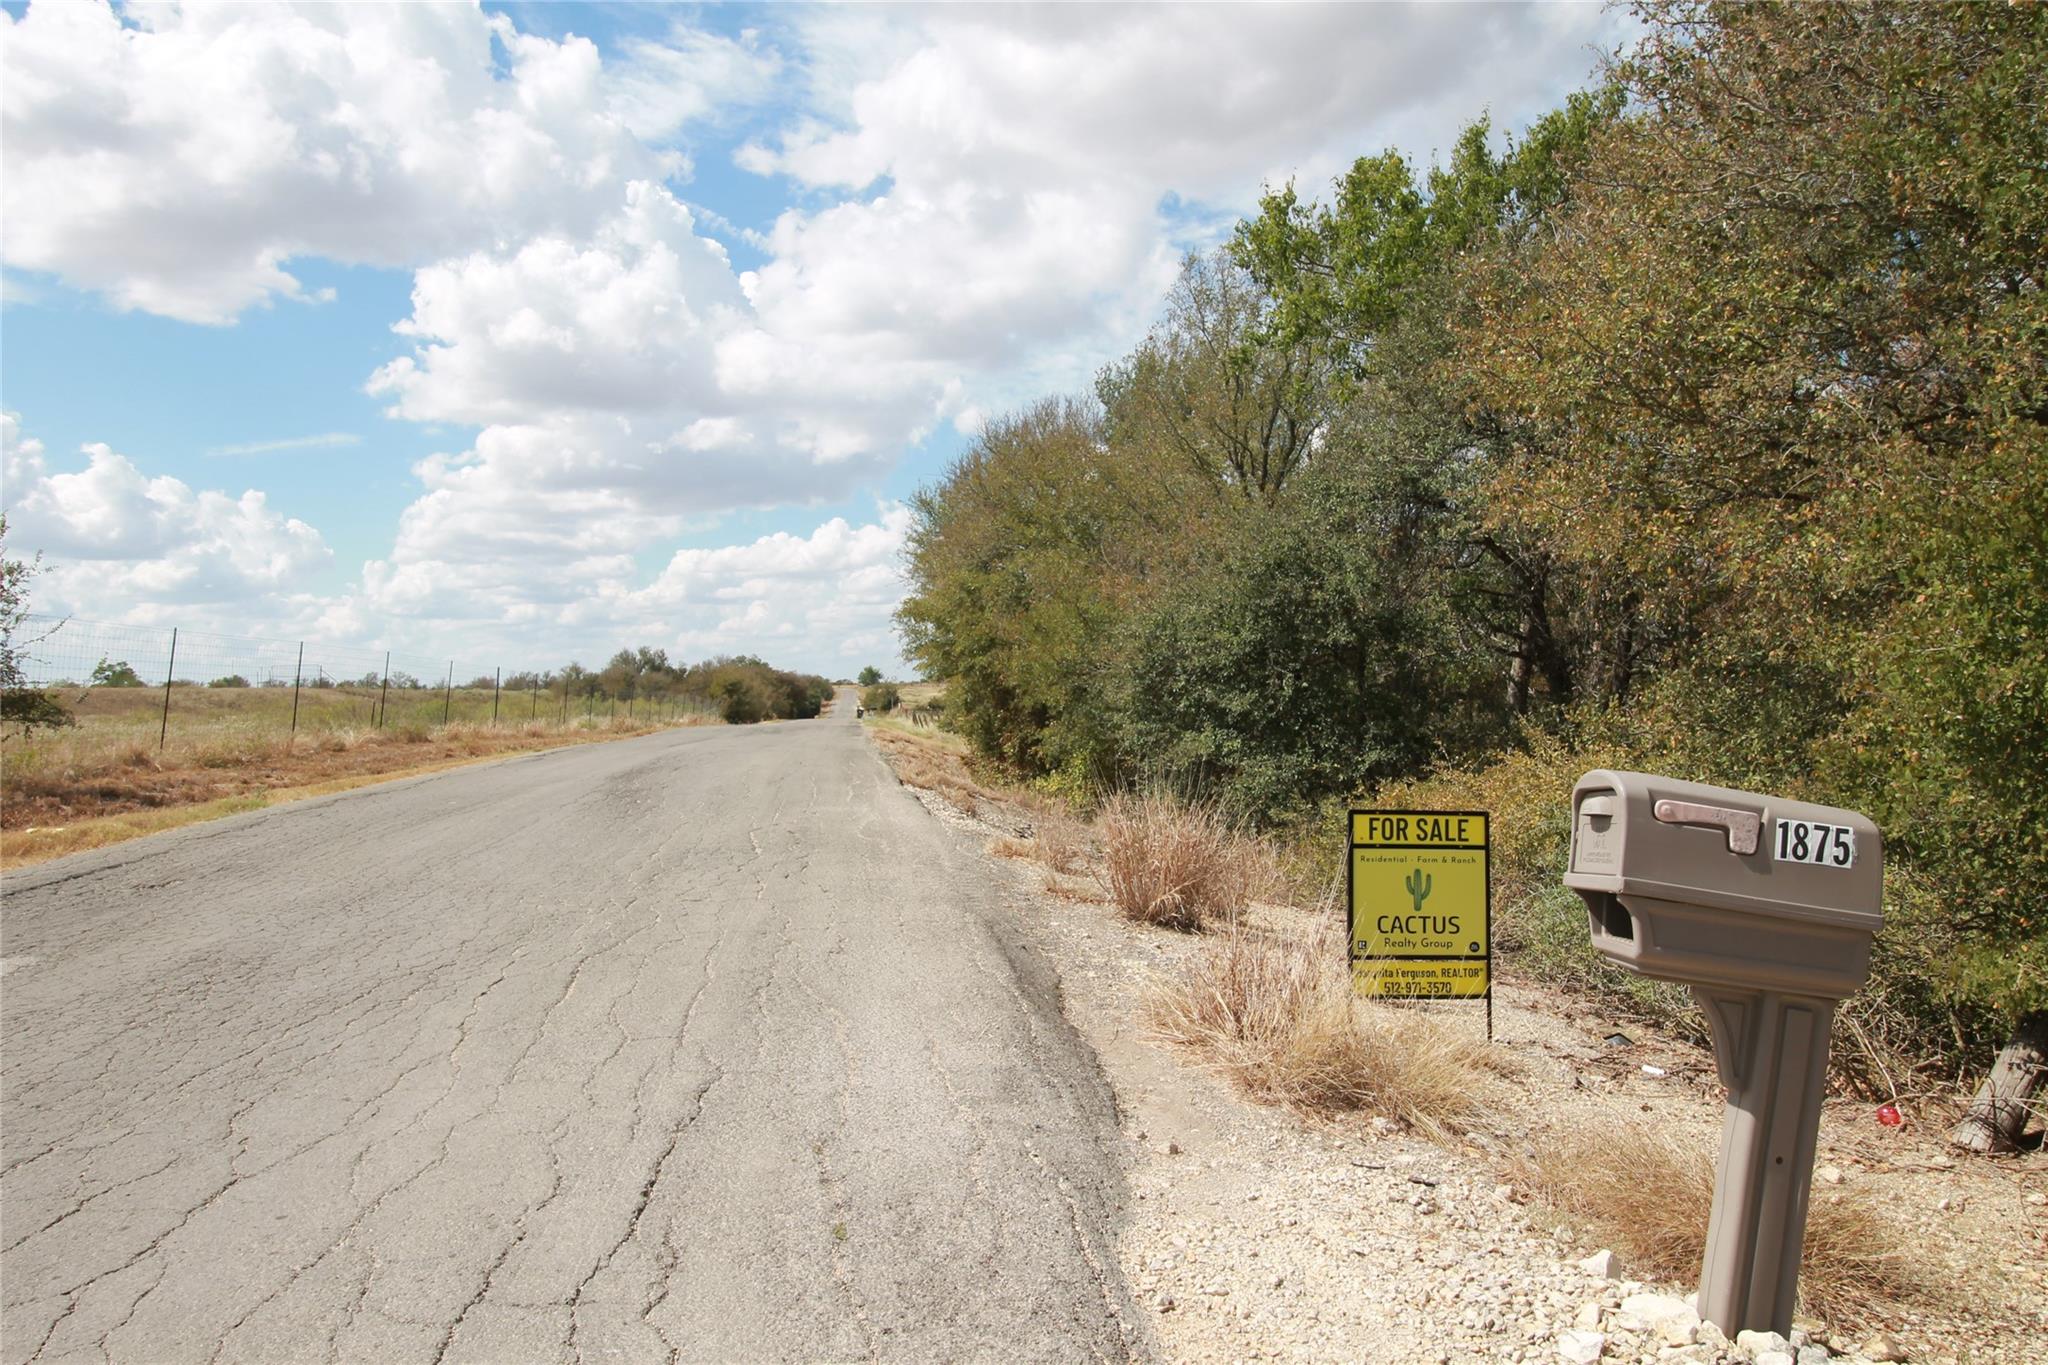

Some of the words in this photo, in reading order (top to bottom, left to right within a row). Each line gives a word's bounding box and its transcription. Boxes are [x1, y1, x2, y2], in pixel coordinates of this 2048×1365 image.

[1369, 817, 1408, 841] FOR
[1416, 818, 1469, 842] SALE
[1777, 820, 1851, 866] 1875
[1360, 855, 1408, 863] Residential
[1417, 855, 1438, 864] Farm
[1441, 856, 1447, 864] &
[1451, 856, 1477, 864] Ranch
[1377, 915, 1460, 935] CACTUS
[1384, 938, 1417, 950] Realty
[1421, 938, 1453, 950] Group
[1384, 981, 1452, 994] 512-971-3570
